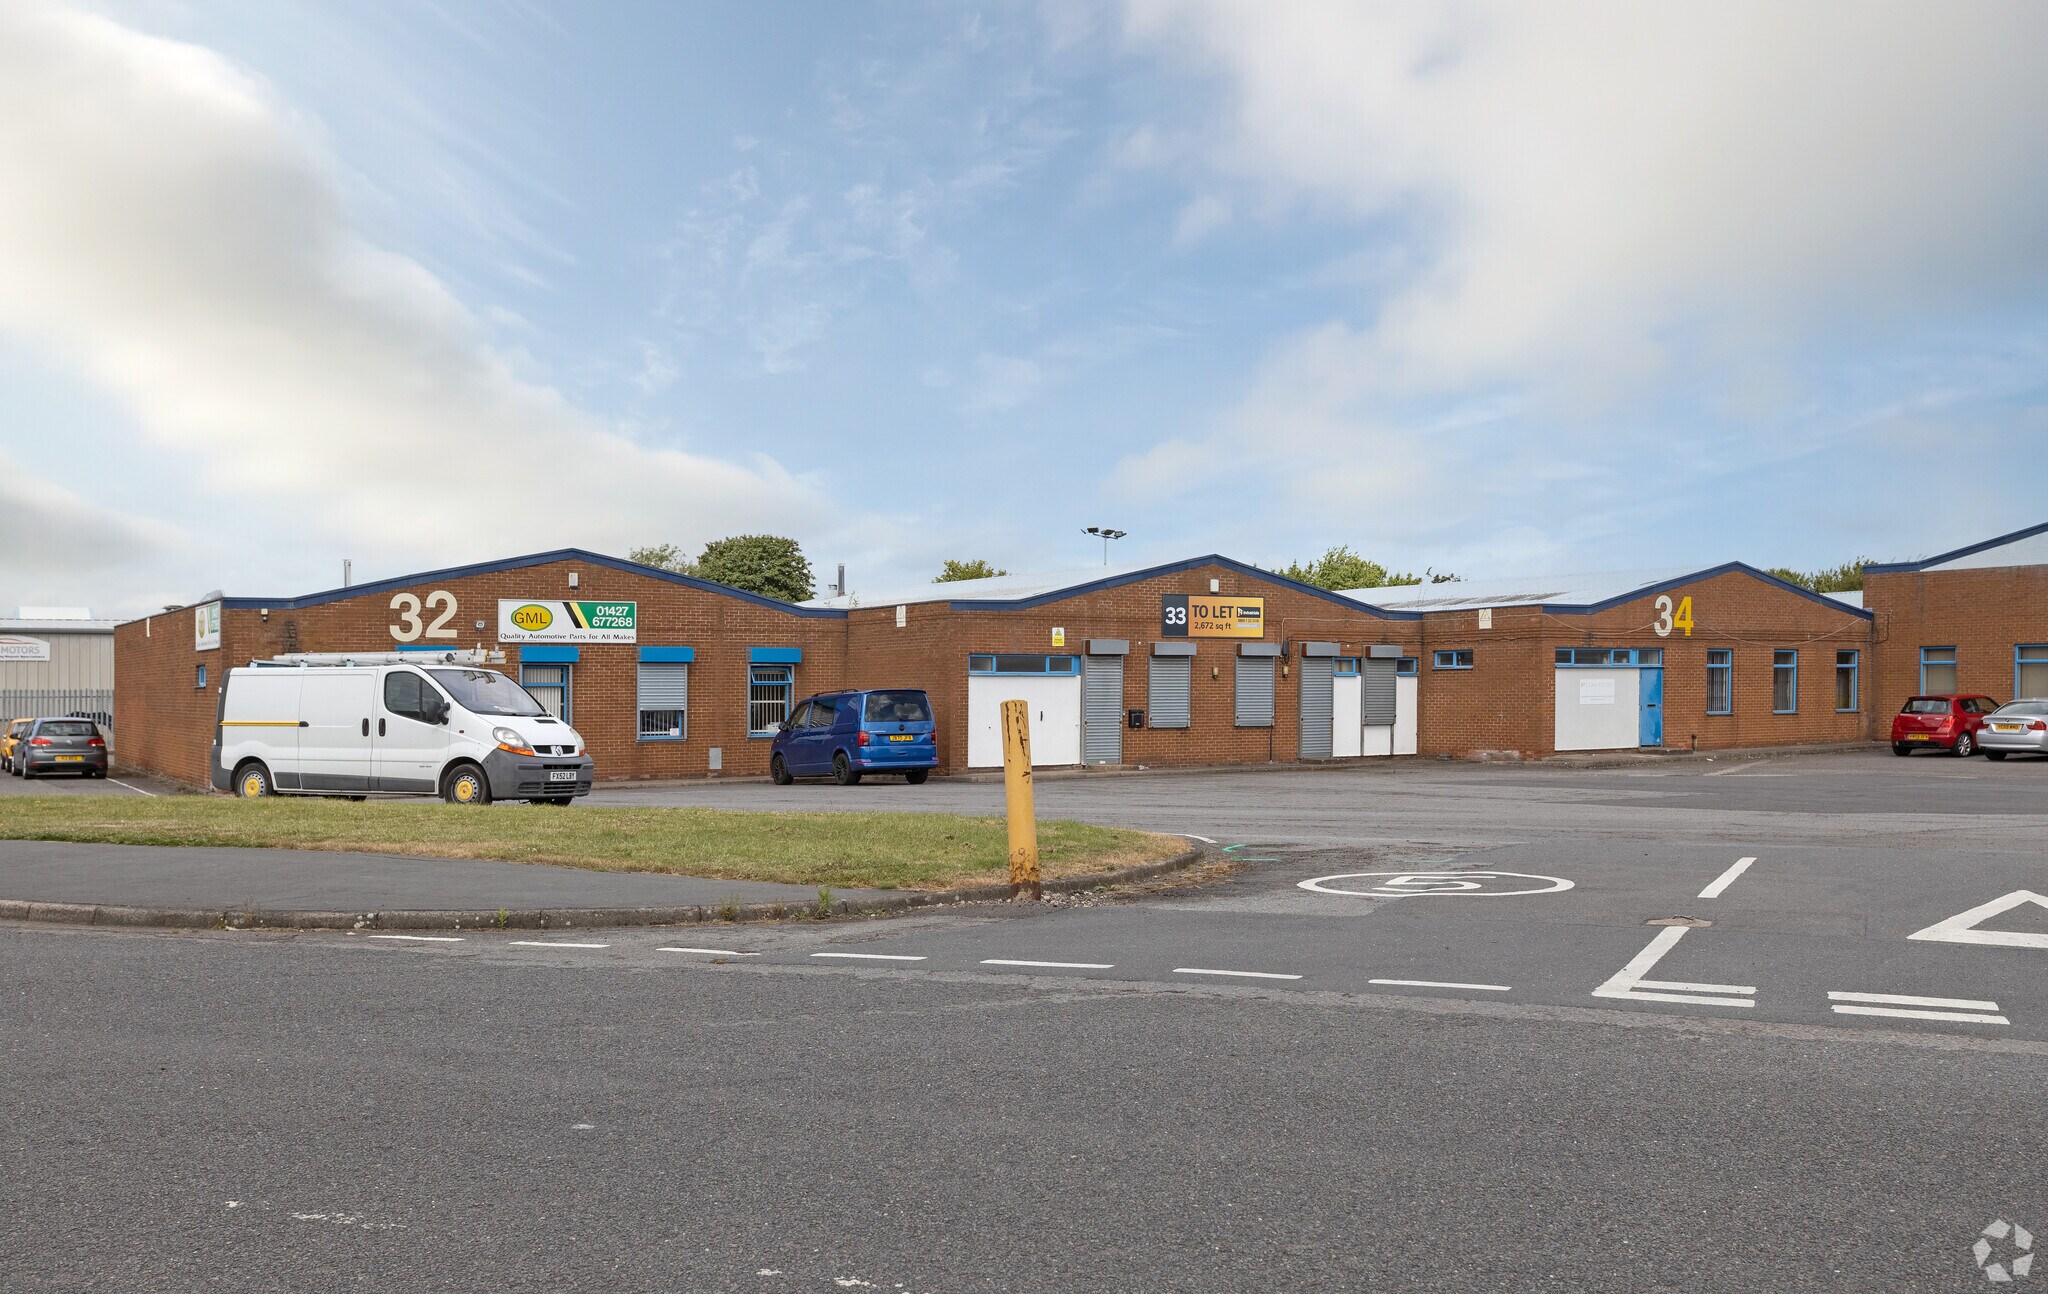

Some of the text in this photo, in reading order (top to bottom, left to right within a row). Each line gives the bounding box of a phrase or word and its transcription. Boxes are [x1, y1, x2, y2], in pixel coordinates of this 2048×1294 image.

[389, 590, 458, 642] 32
[596, 605, 629, 616] 01427
[1165, 606, 1187, 625] 33
[1192, 604, 1234, 619] TO LET
[1653, 595, 1694, 637] 34
[514, 611, 547, 624] GML
[592, 616, 633, 627] 677268
[1194, 621, 1214, 630] 2,672
[1215, 623, 1224, 631] sq
[1225, 622, 1232, 630] ft
[500, 633, 526, 641] Quality
[1, 646, 40, 654] MOTORS
